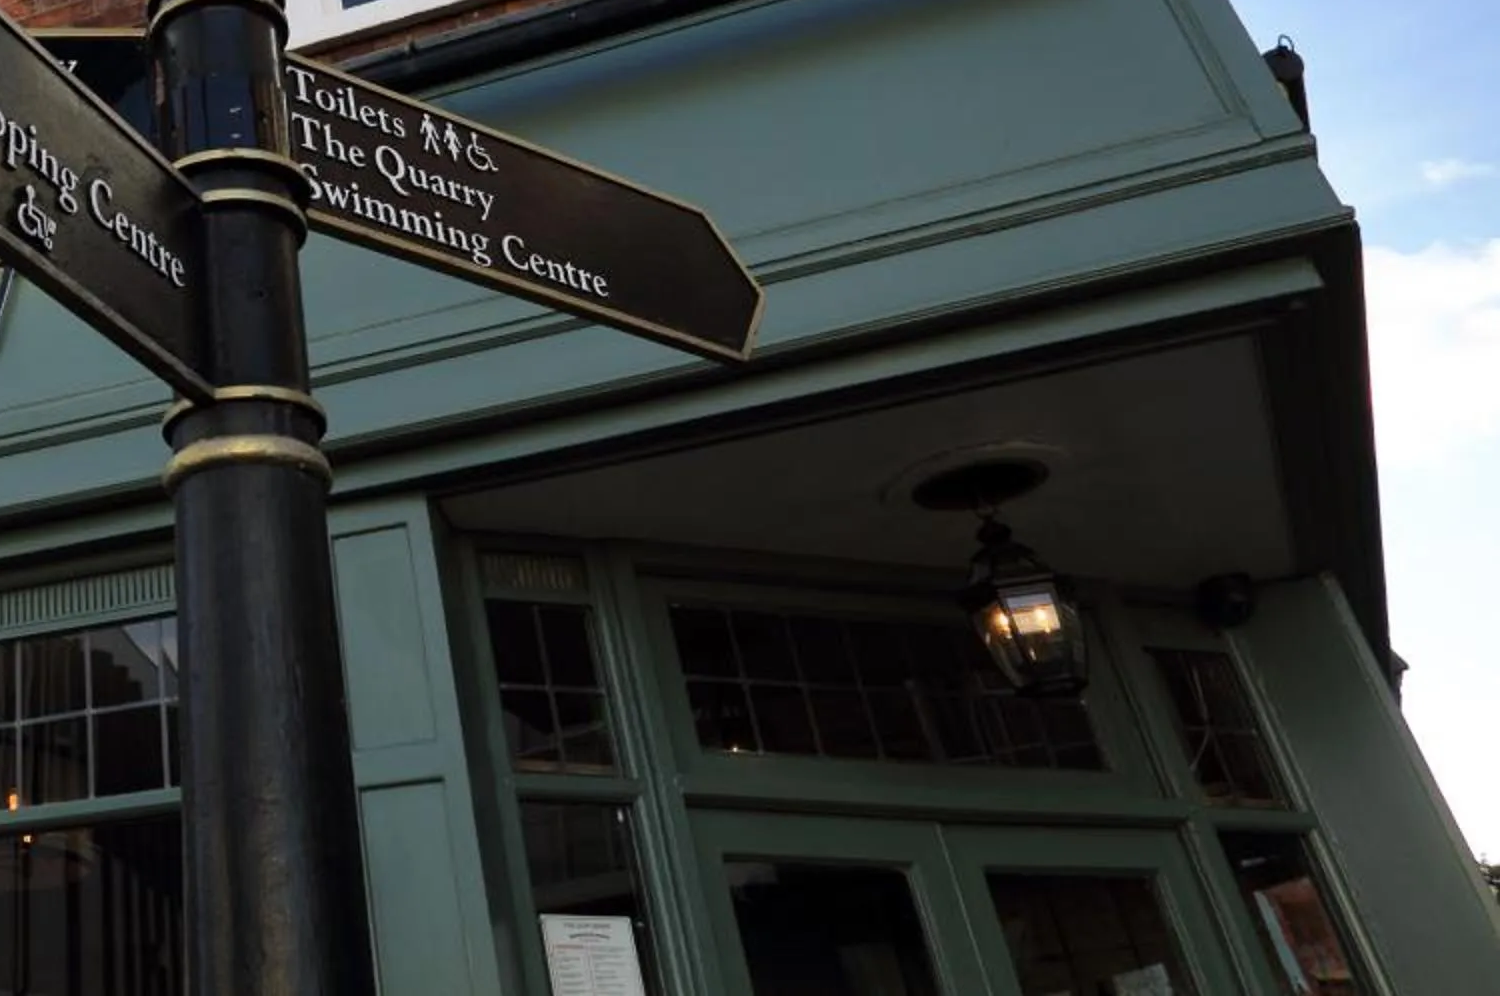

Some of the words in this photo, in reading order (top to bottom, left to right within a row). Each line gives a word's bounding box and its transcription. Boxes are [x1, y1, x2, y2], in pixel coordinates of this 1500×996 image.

[286, 65, 406, 138] Toilets
[292, 112, 366, 167] The
[375, 145, 495, 221] Quarry
[90, 179, 185, 287] Centre
[300, 163, 492, 268] Swimming
[502, 234, 609, 298] Centre
